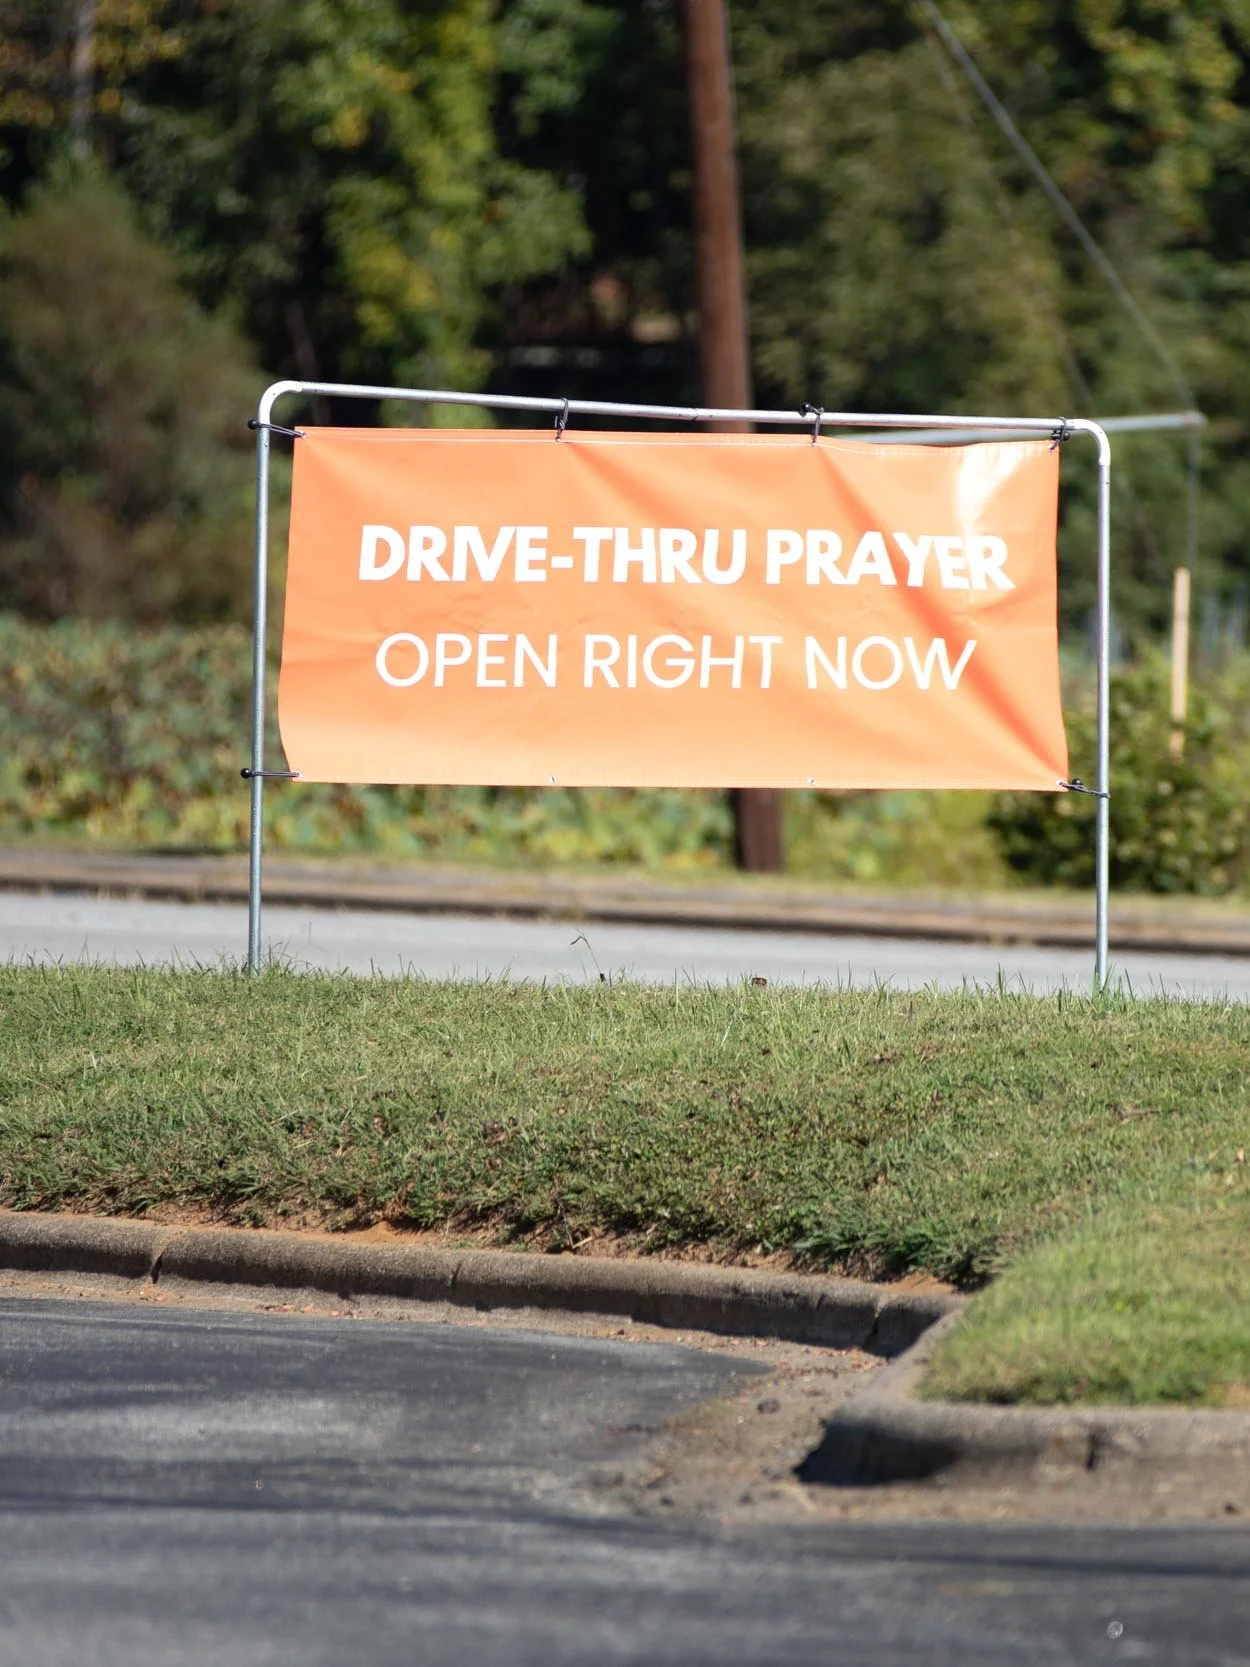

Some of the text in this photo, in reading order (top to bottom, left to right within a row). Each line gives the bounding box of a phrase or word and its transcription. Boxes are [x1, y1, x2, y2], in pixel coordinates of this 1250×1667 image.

[358, 524, 1016, 591] DRIVE-THRU PRAYER
[375, 632, 977, 691] OPEN RIGHT NOW
